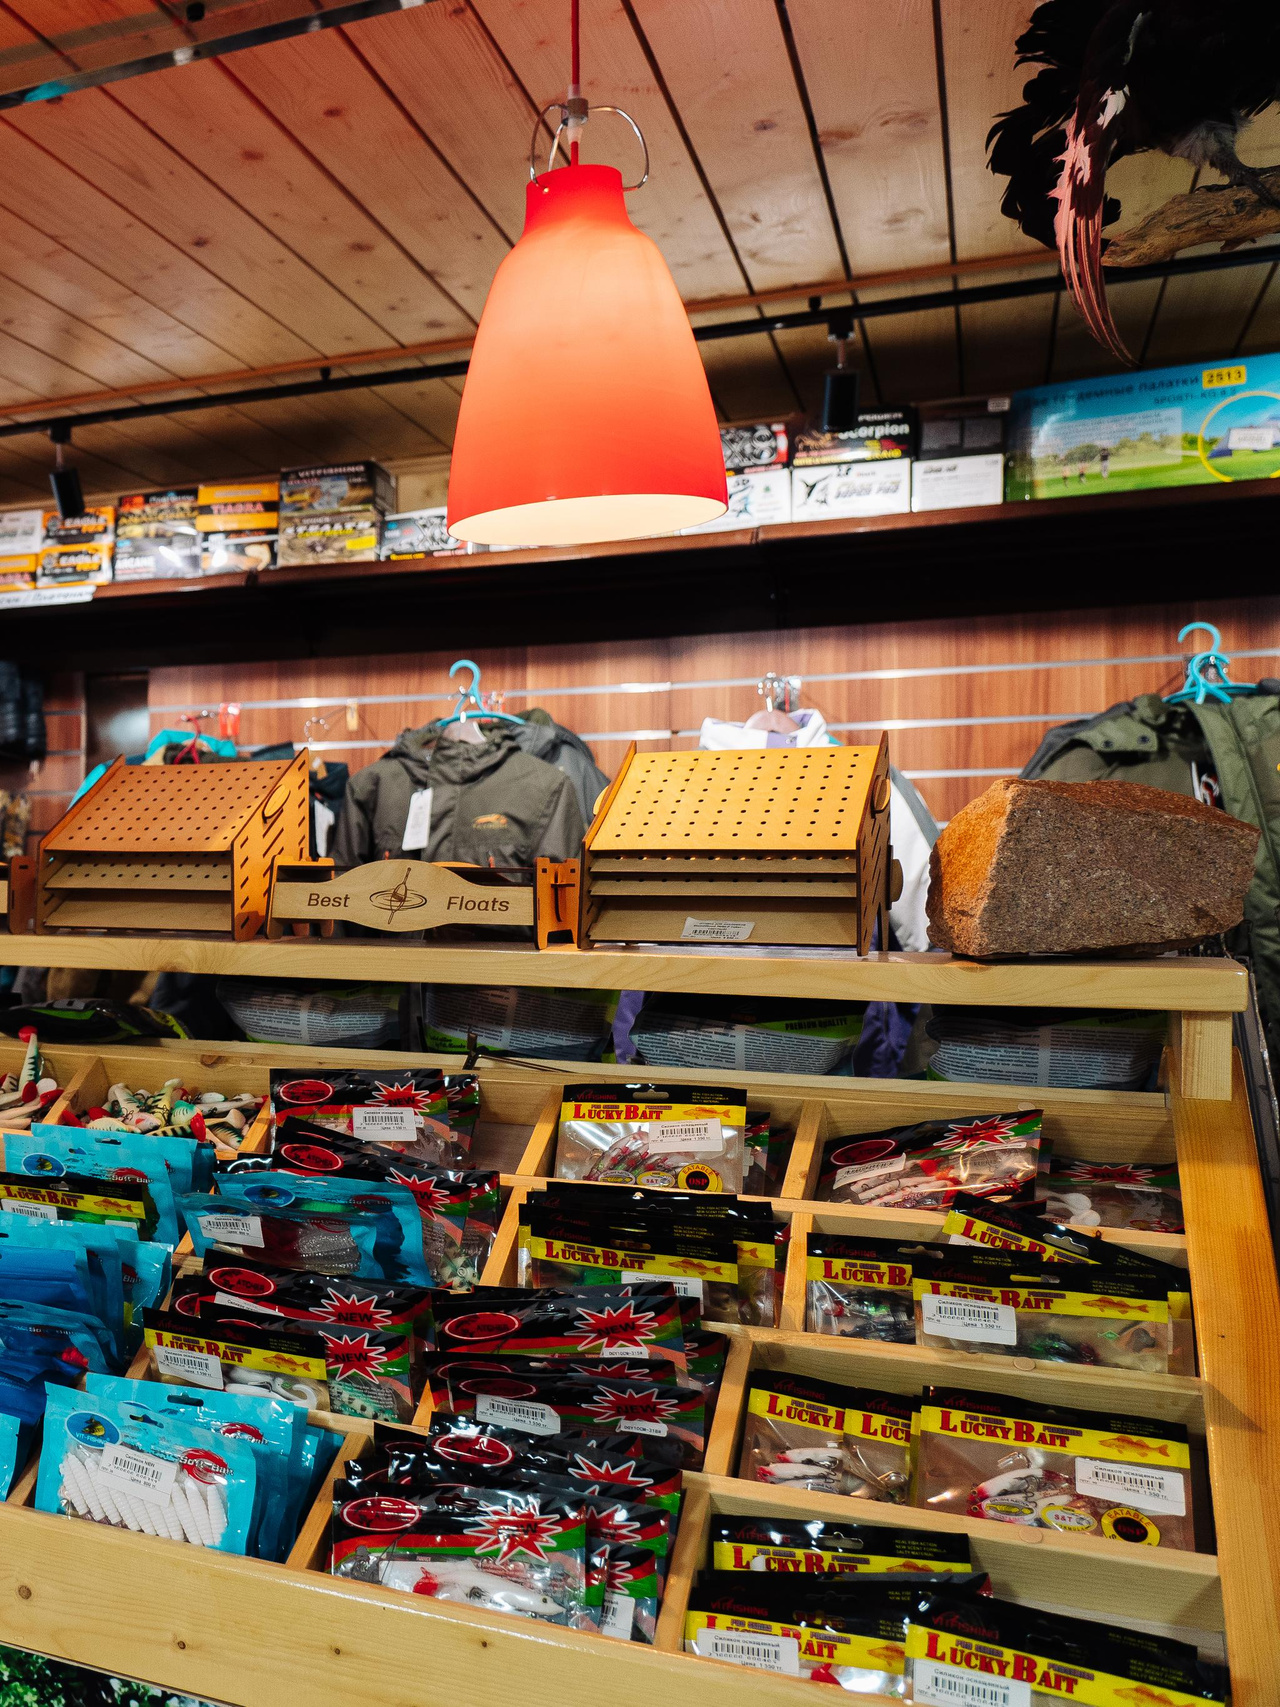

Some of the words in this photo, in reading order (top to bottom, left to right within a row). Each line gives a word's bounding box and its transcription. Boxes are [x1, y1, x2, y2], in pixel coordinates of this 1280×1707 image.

[307, 892, 351, 908] Best
[446, 896, 510, 912] Floats
[388, 1096, 416, 1106] NEW
[681, 1164, 715, 1178] EATABLE
[937, 1299, 963, 1307] Силикон
[337, 1312, 373, 1323] NEW
[596, 1321, 637, 1337] NEW
[334, 1352, 371, 1364] NEW
[615, 1403, 659, 1415] NEW
[179, 1455, 204, 1469] Soft
[1094, 1465, 1122, 1474] Силикон
[1054, 1514, 1073, 1522] S&T
[1106, 1510, 1152, 1528] EATABLE
[714, 1635, 741, 1643] Силикон
[934, 1668, 964, 1680] Силикон
